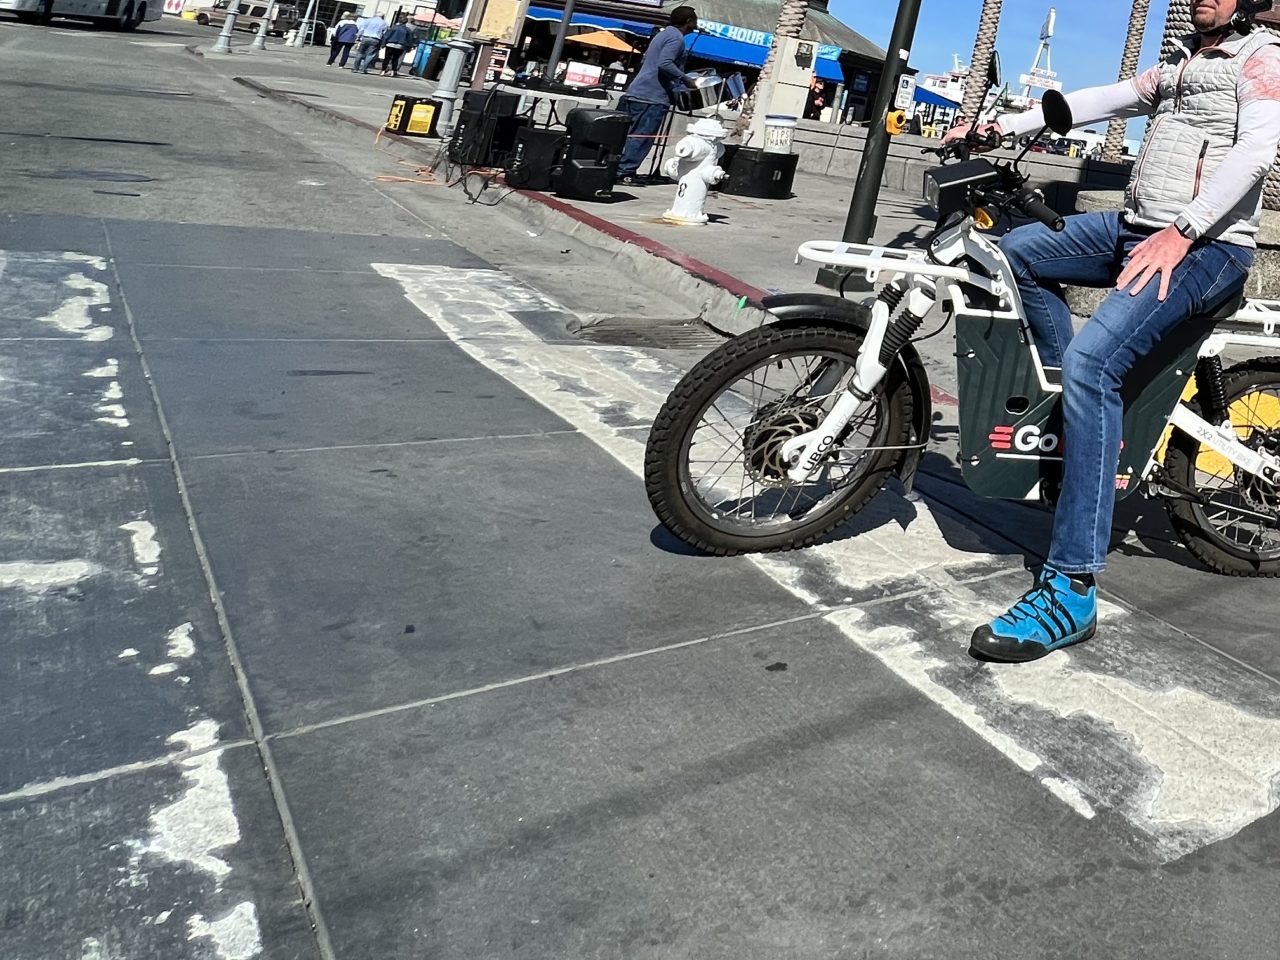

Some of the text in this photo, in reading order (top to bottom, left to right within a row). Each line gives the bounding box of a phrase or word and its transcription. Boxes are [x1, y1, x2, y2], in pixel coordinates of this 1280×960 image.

[697, 19, 725, 34] PPY
[729, 25, 765, 45] HOUR
[678, 182, 688, 198] 8
[802, 435, 834, 471] UBCO
